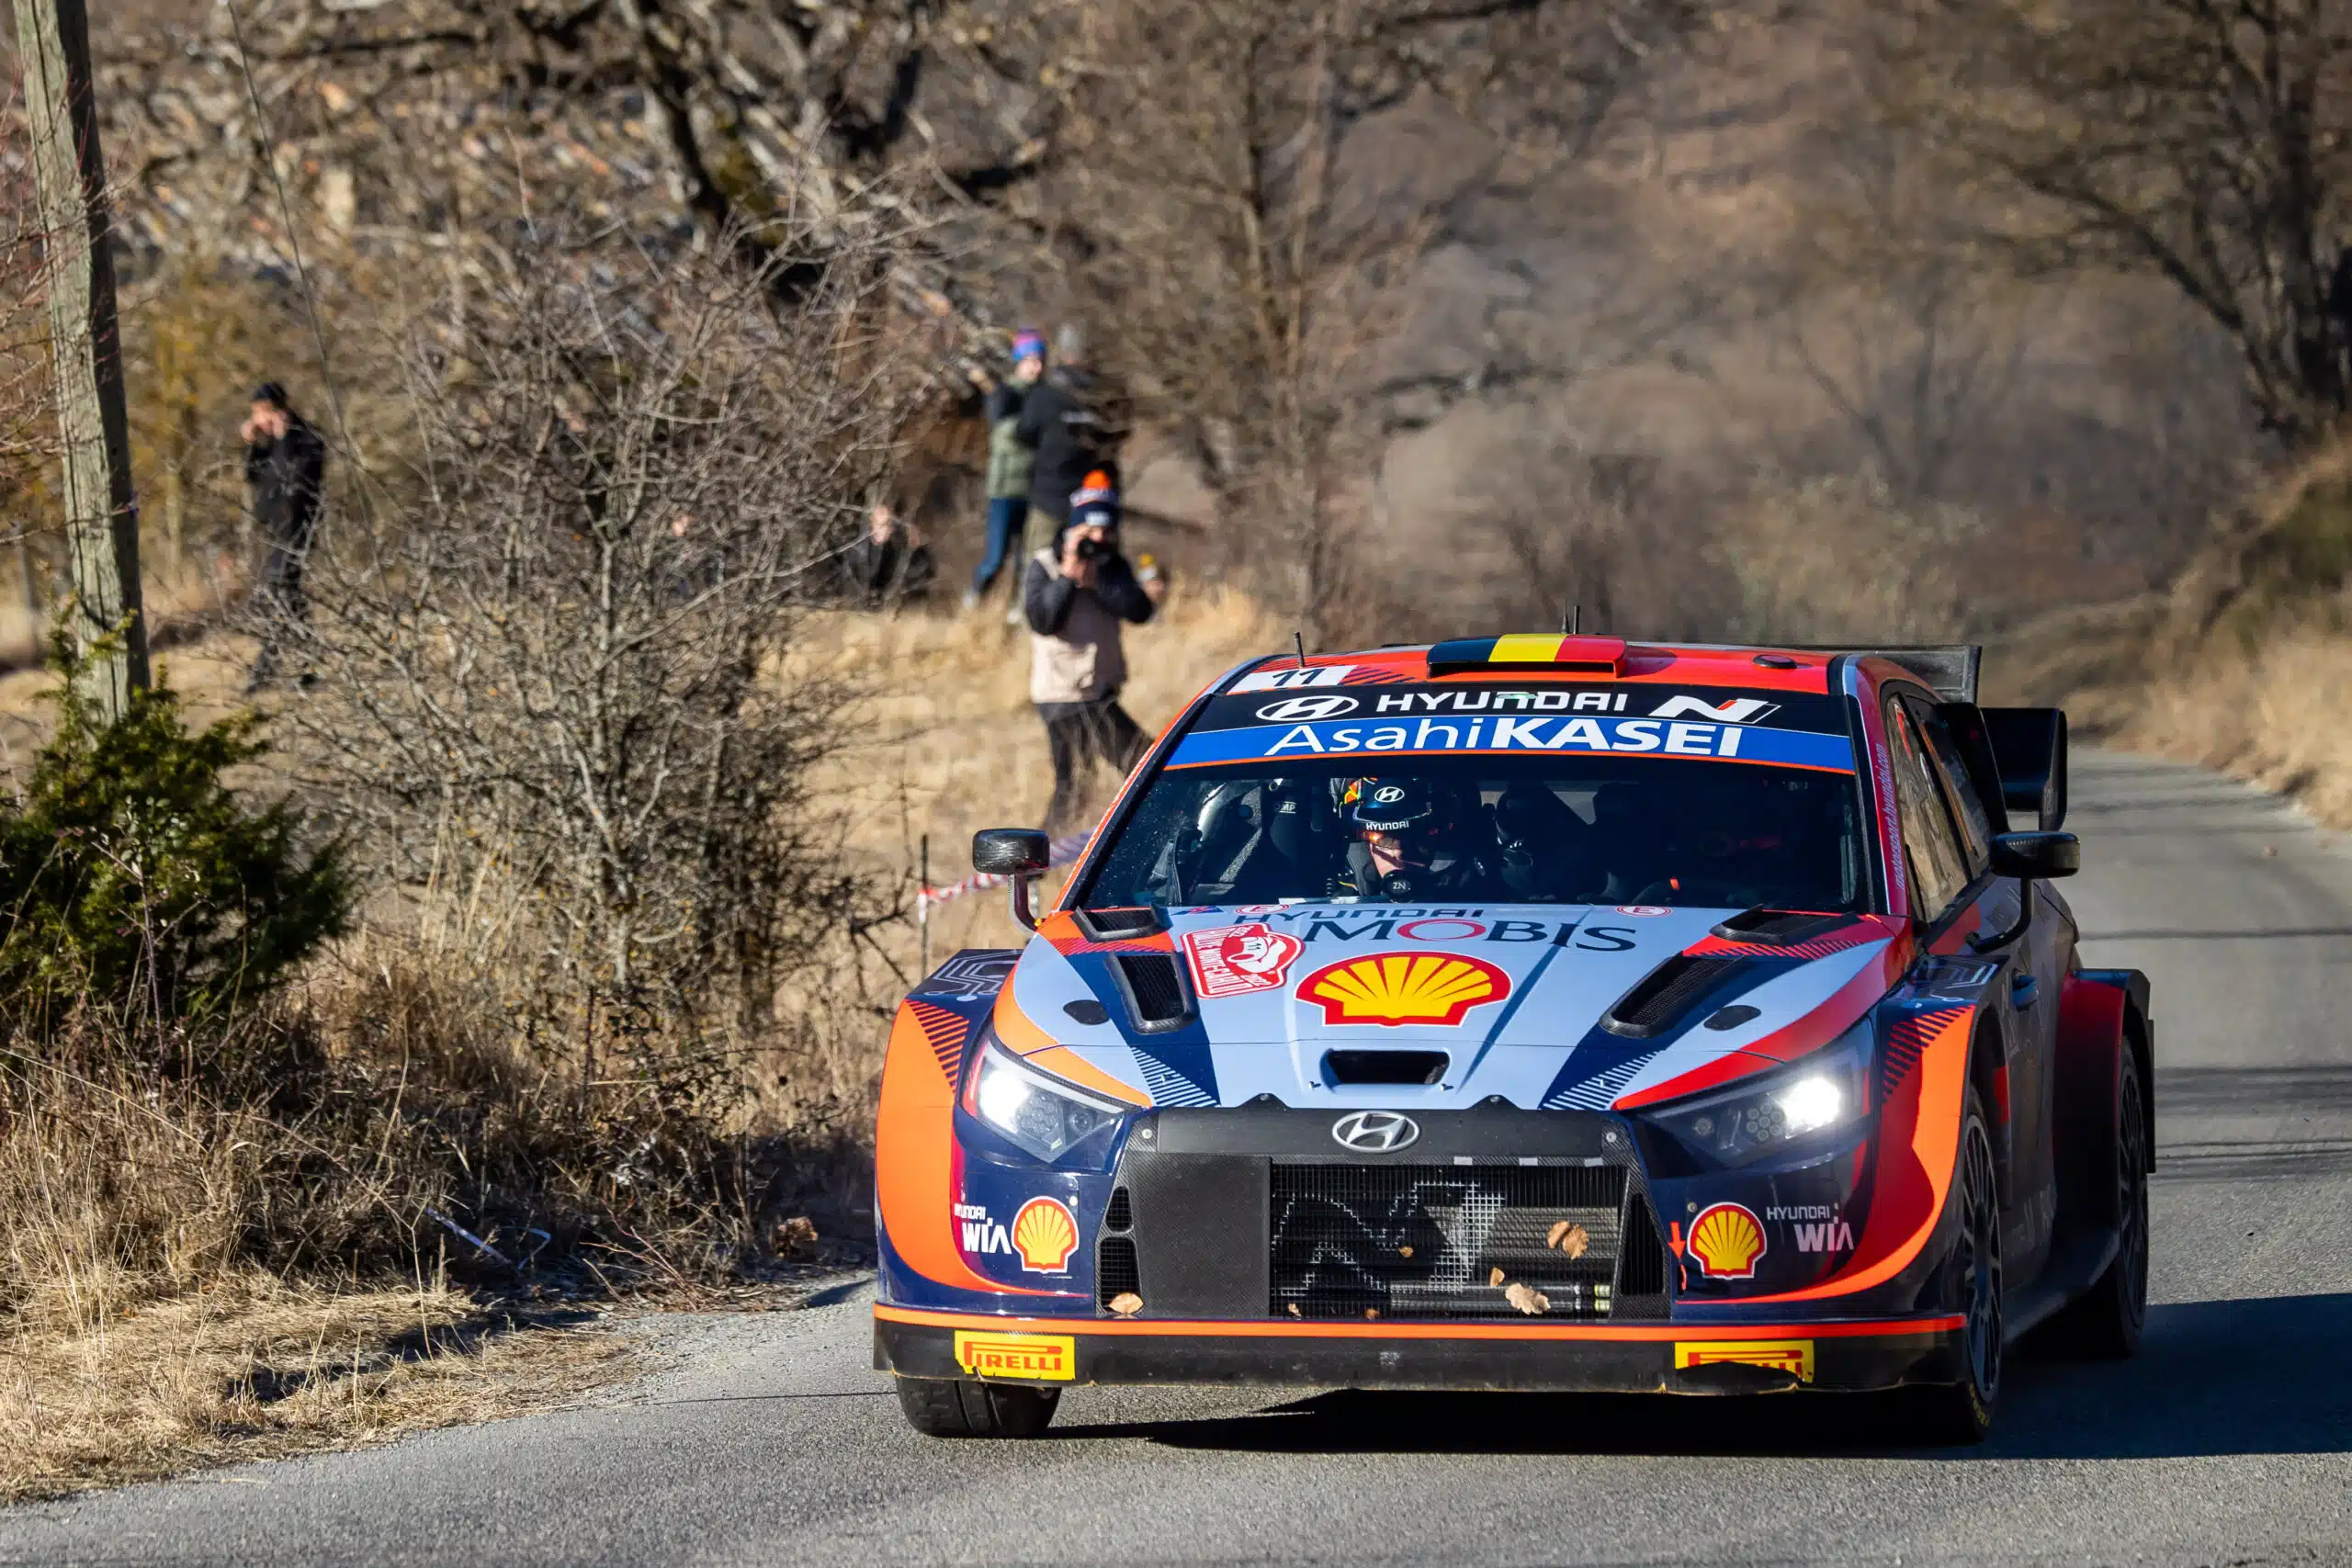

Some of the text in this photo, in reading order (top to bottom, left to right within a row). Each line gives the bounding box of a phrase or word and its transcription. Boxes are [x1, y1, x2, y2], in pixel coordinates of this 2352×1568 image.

[1273, 668, 1328, 687] 11
[1375, 691, 1628, 713] HYUNDAI
[1365, 820, 1409, 831] HYUNDAI
[1233, 909, 1485, 925] HYUNDAI
[1303, 919, 1637, 952] MOBIS
[1247, 942, 1262, 951] 11
[1766, 1205, 1830, 1220] HYUNDAI
[961, 1219, 1012, 1255] WIA
[1793, 1219, 1854, 1252] WIA
[964, 1341, 1063, 1371] PIRELLI
